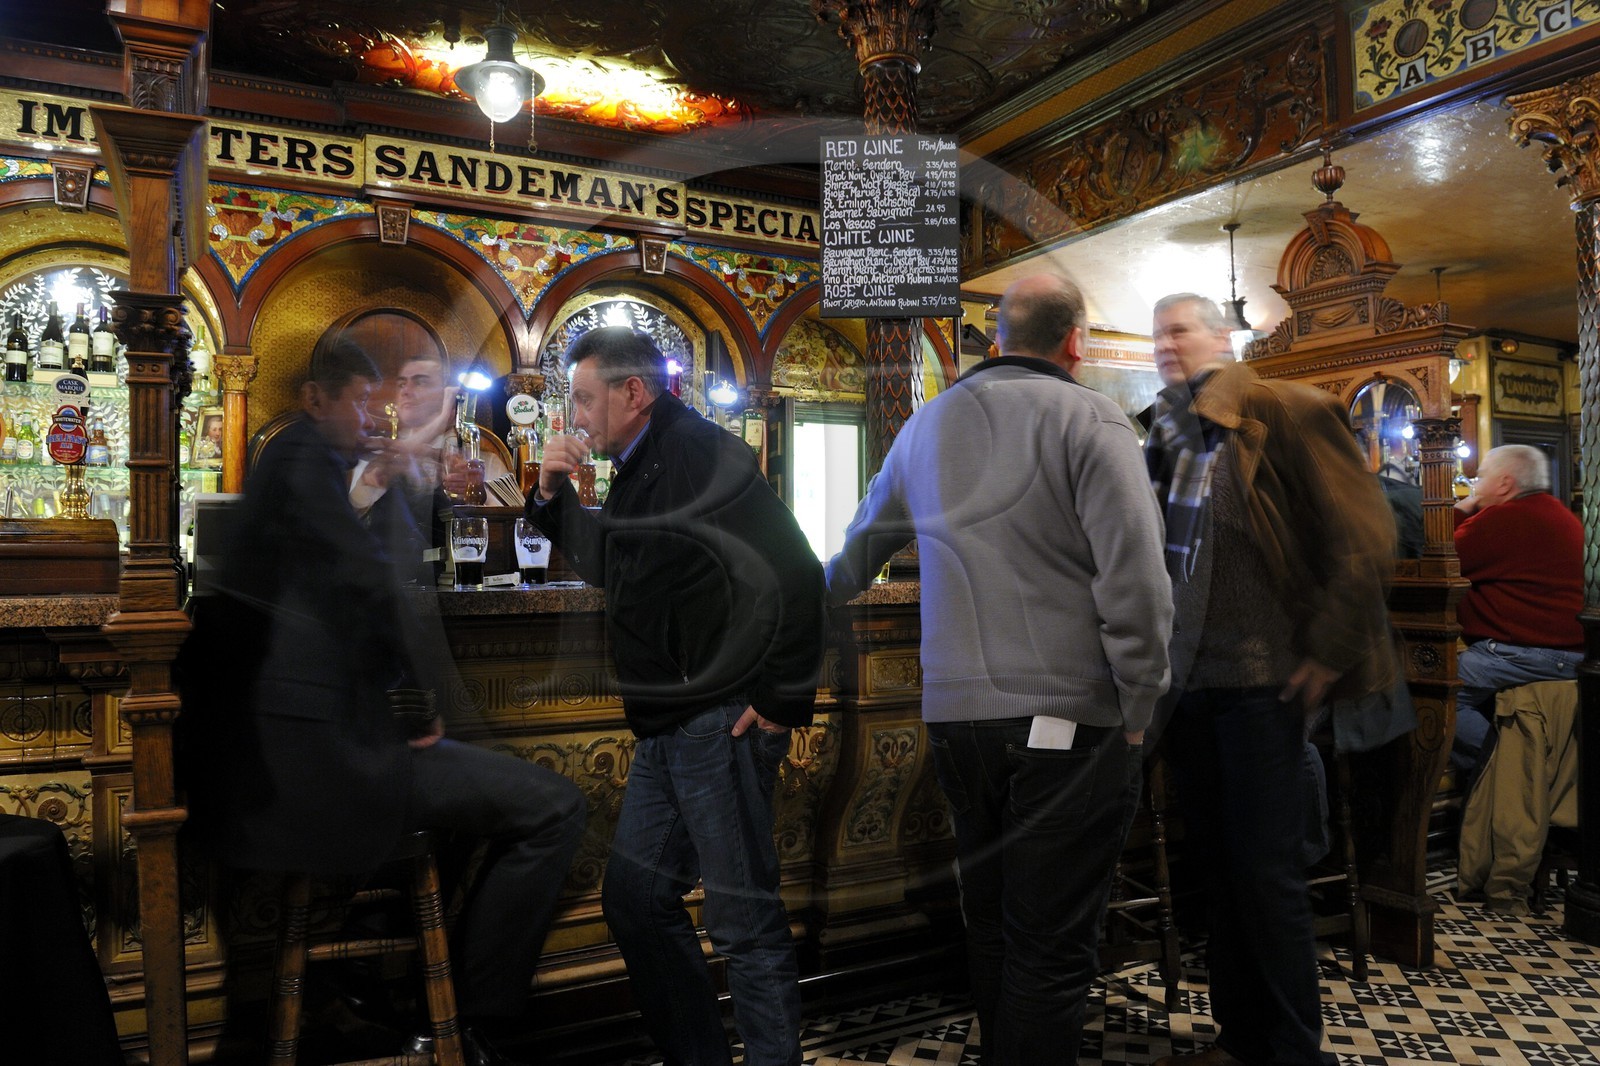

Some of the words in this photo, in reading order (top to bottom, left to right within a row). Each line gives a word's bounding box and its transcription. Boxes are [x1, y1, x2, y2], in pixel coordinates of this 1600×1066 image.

[1402, 64, 1424, 90] A
[1469, 37, 1493, 63] B
[1543, 6, 1566, 33] C
[826, 141, 857, 157] RED
[864, 139, 903, 156] WINE
[863, 158, 902, 170] Sendero
[824, 170, 846, 181] Pinot
[870, 170, 897, 182] Oyster
[899, 168, 915, 182] Bay
[861, 179, 881, 191] Wolf
[883, 180, 909, 191] Blass
[884, 189, 893, 197] de
[895, 185, 921, 197] Riscal
[375, 145, 680, 217] SANDEMAN'S
[686, 197, 820, 241] SPECIA
[839, 199, 871, 209] Emilion
[873, 197, 917, 209] Rothschild
[823, 208, 864, 218] Cabernet
[867, 206, 913, 220] Sauvignon
[925, 204, 946, 213] 24.95
[823, 218, 841, 230] Los
[843, 218, 876, 230] Vascos
[824, 231, 872, 246] WHITE
[878, 229, 915, 243] WINE
[892, 247, 922, 257] Sendero
[823, 257, 864, 267] Sauvignon
[893, 256, 917, 267] Oyster
[917, 256, 930, 267] Bay
[822, 274, 841, 284] Pino
[871, 273, 905, 284] Antonio
[906, 273, 932, 285] Rubini
[863, 283, 896, 298] WINE
[513, 405, 535, 415] Grolsch
